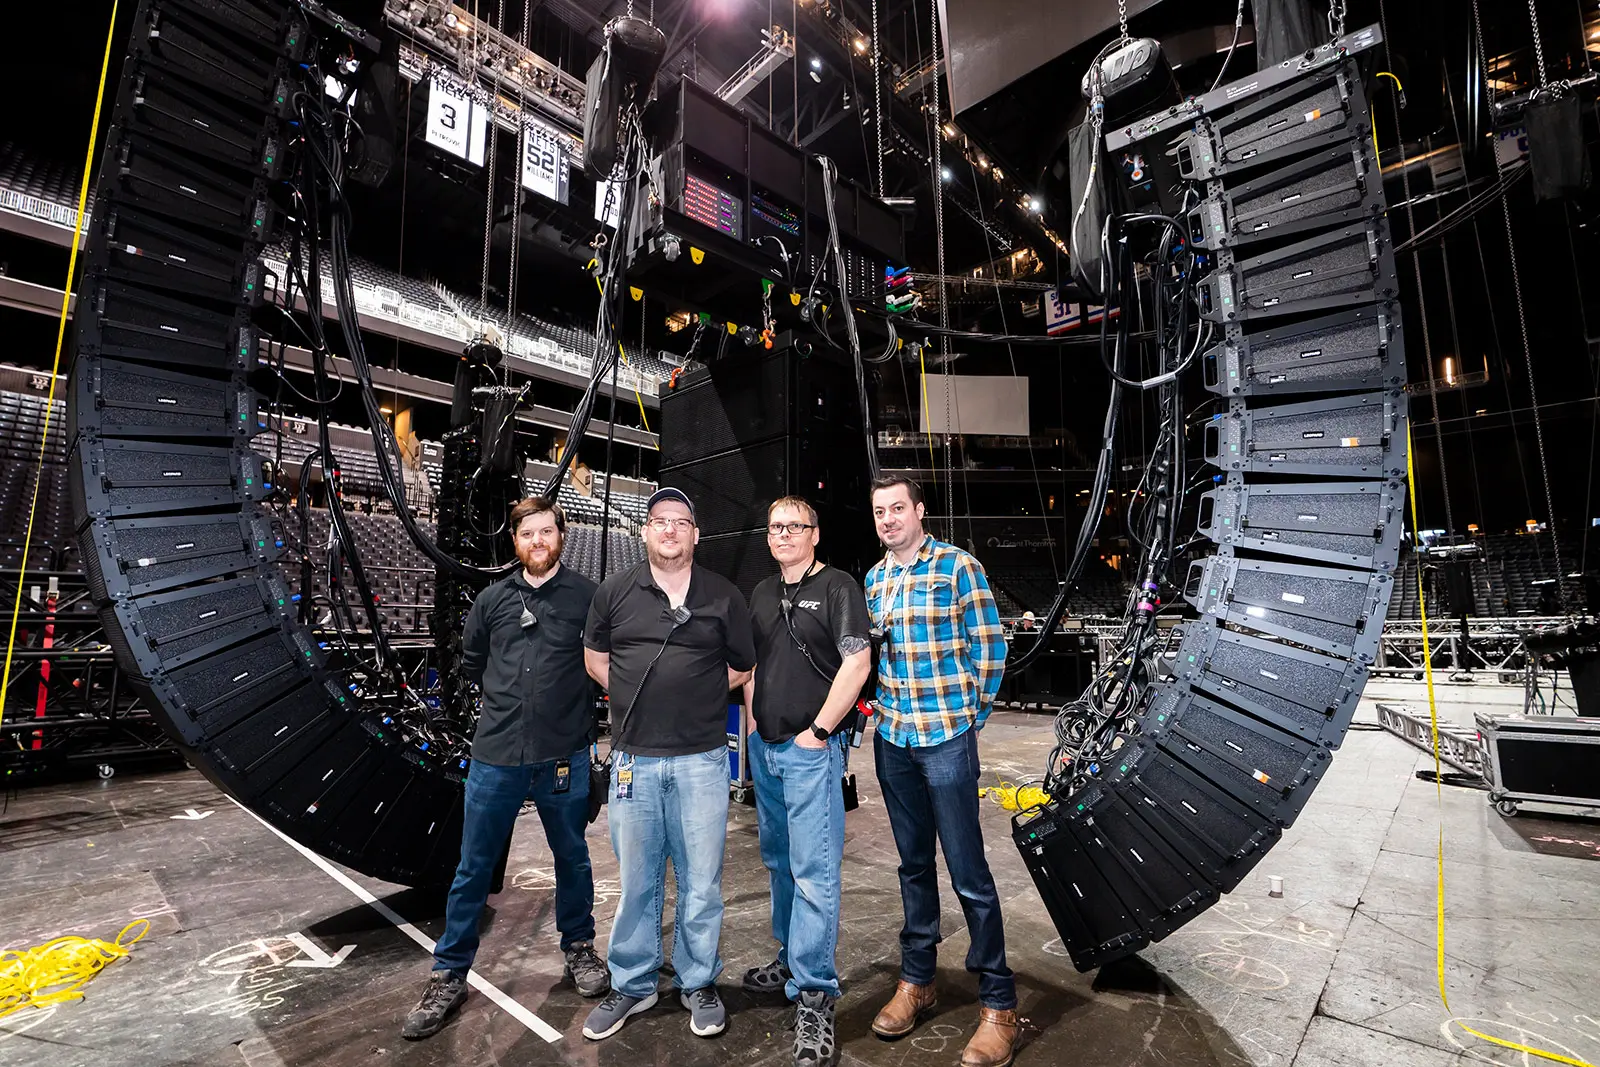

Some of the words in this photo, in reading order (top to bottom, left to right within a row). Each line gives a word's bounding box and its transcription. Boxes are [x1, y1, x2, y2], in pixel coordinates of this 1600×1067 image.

[440, 103, 457, 130] 3
[529, 132, 556, 154] NETS
[527, 143, 555, 174] 52
[526, 165, 554, 184] WILLIAMS
[1053, 301, 1072, 319] 31
[1003, 539, 1023, 547] Grant
[1024, 539, 1056, 547] Thornton
[798, 599, 821, 610] UFC
